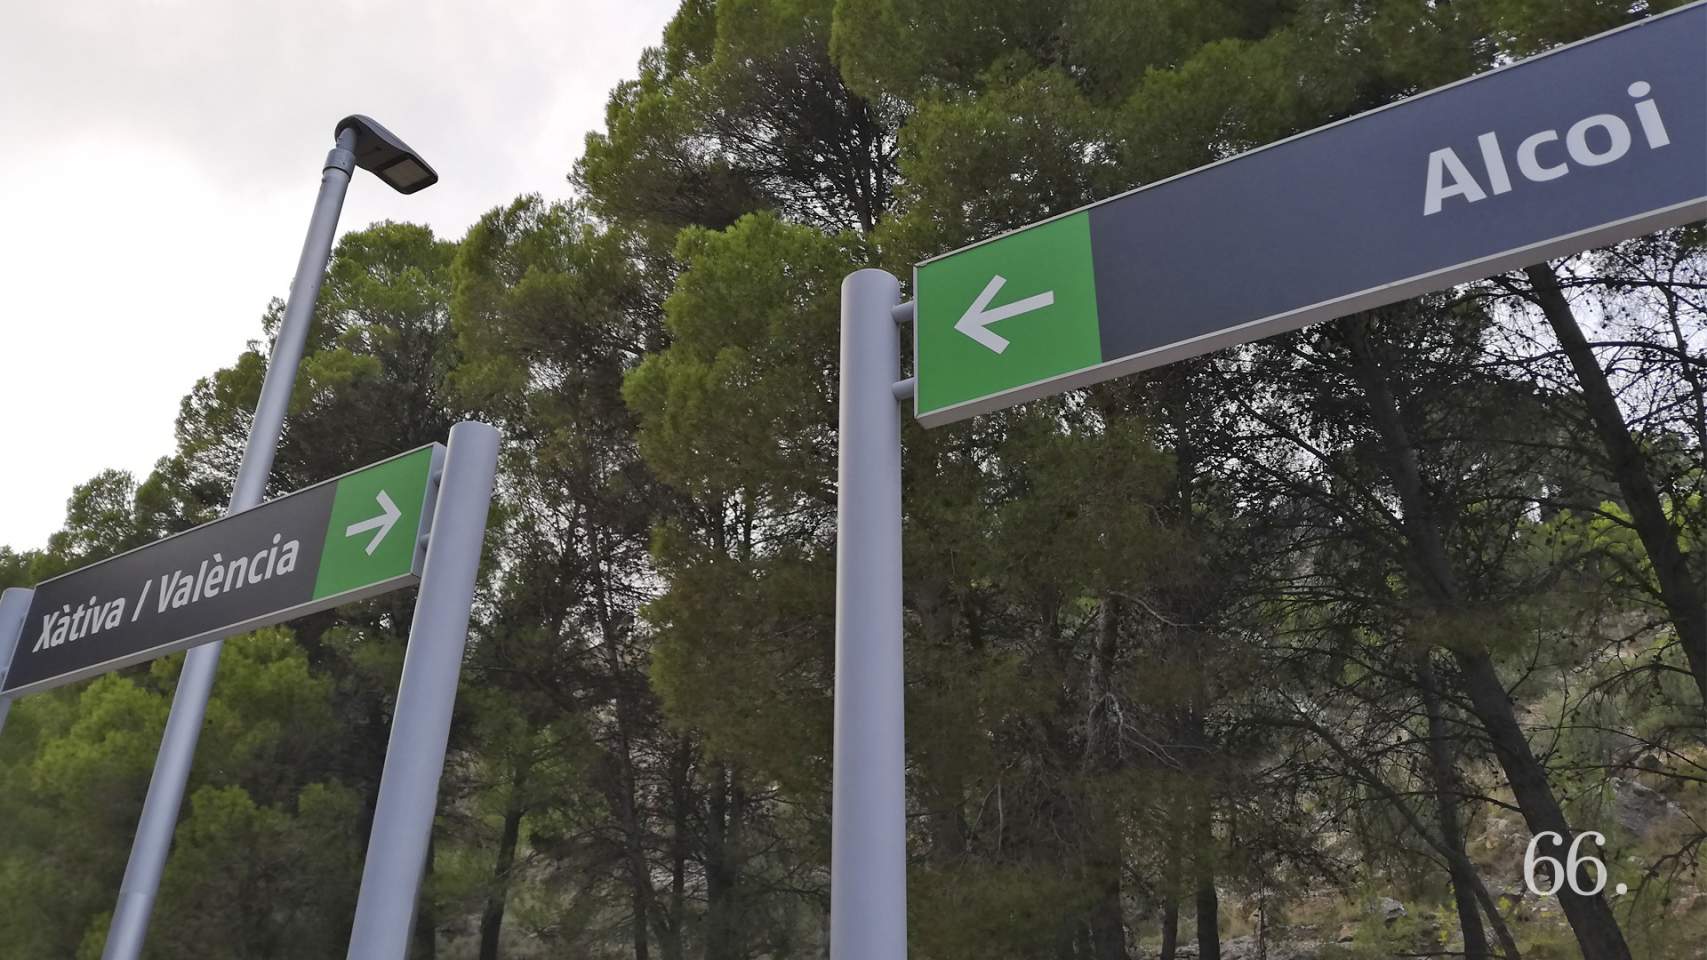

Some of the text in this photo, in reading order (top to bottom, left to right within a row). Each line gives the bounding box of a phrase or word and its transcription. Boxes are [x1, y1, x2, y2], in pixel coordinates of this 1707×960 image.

[1423, 80, 1671, 216] Alcoi
[32, 533, 300, 653] Xàtiva / València
